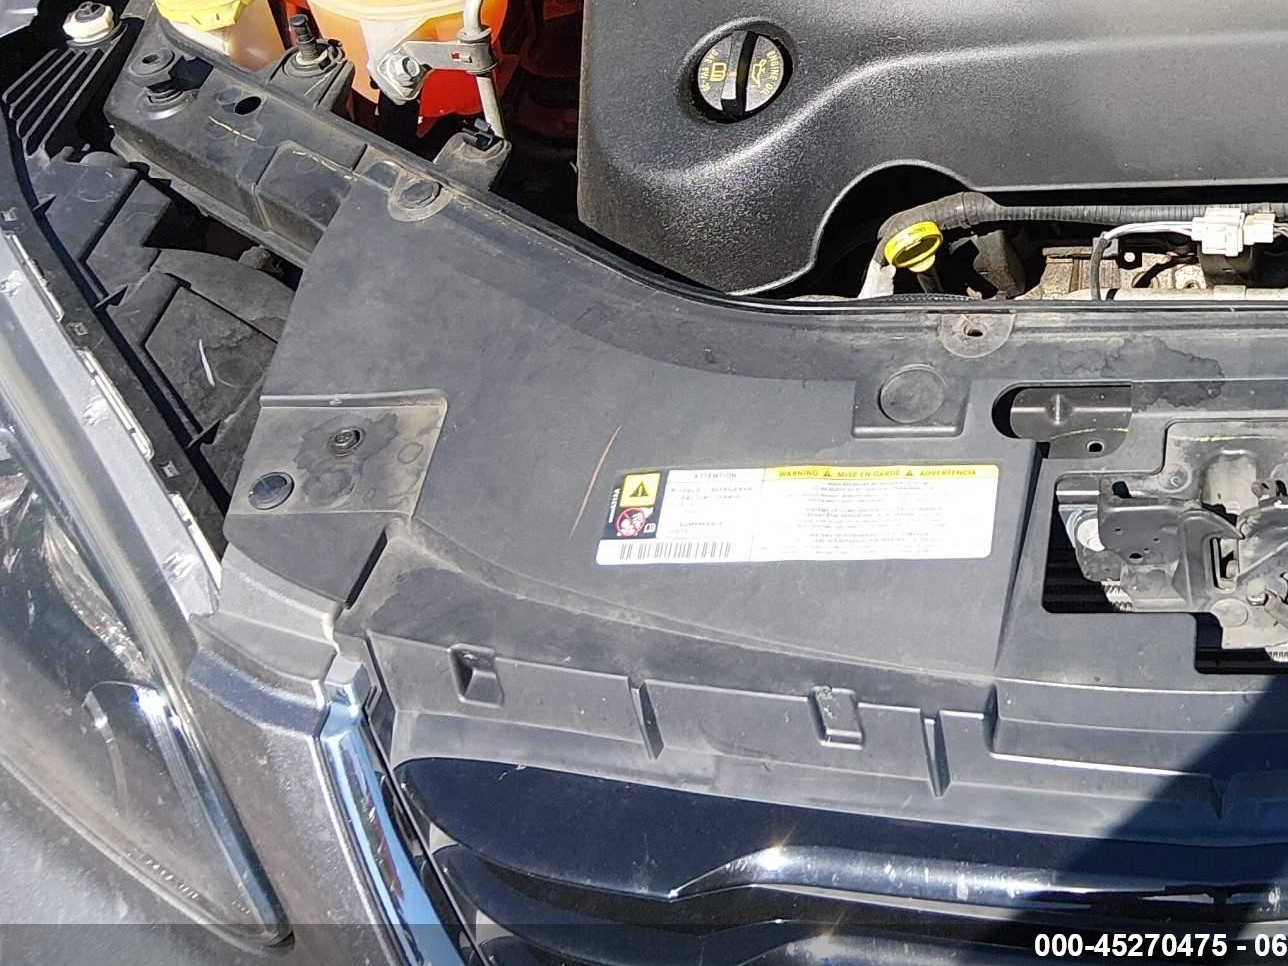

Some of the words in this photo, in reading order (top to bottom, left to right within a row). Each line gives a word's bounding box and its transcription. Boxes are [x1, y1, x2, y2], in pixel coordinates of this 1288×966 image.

[767, 50, 779, 81] ENGINE
[760, 83, 773, 96] OIL
[779, 469, 818, 478] WARNING
[837, 470, 856, 478] MISE
[860, 470, 870, 478] EN
[873, 469, 900, 478] GARDE
[919, 469, 977, 477] ADVERTENCIA
